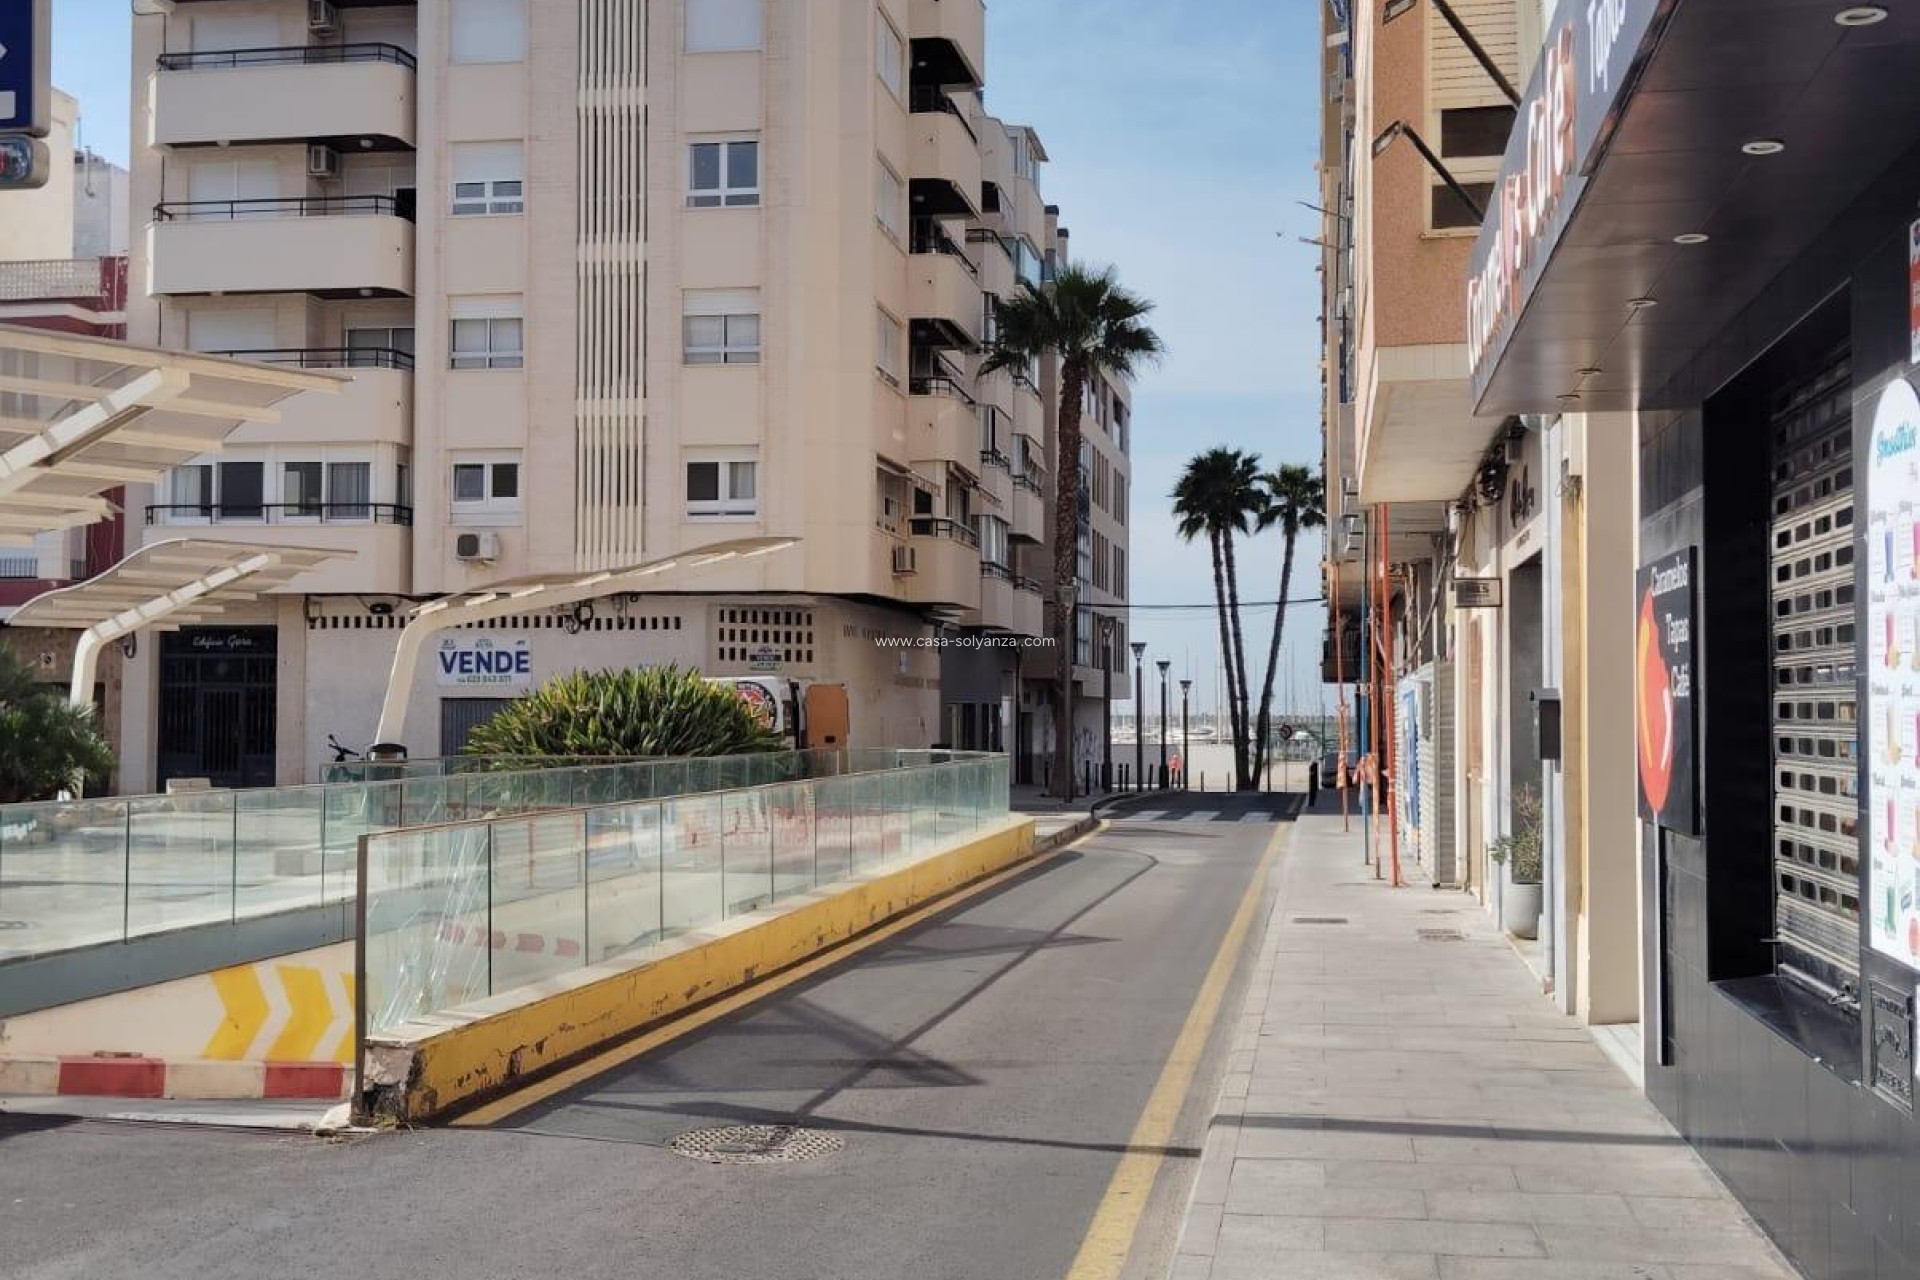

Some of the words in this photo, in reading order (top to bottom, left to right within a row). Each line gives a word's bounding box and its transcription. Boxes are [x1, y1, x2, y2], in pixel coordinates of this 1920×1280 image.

[1665, 612, 1690, 654] Tapas
[438, 650, 530, 675] VENDE
[1670, 663, 1691, 698] Café
